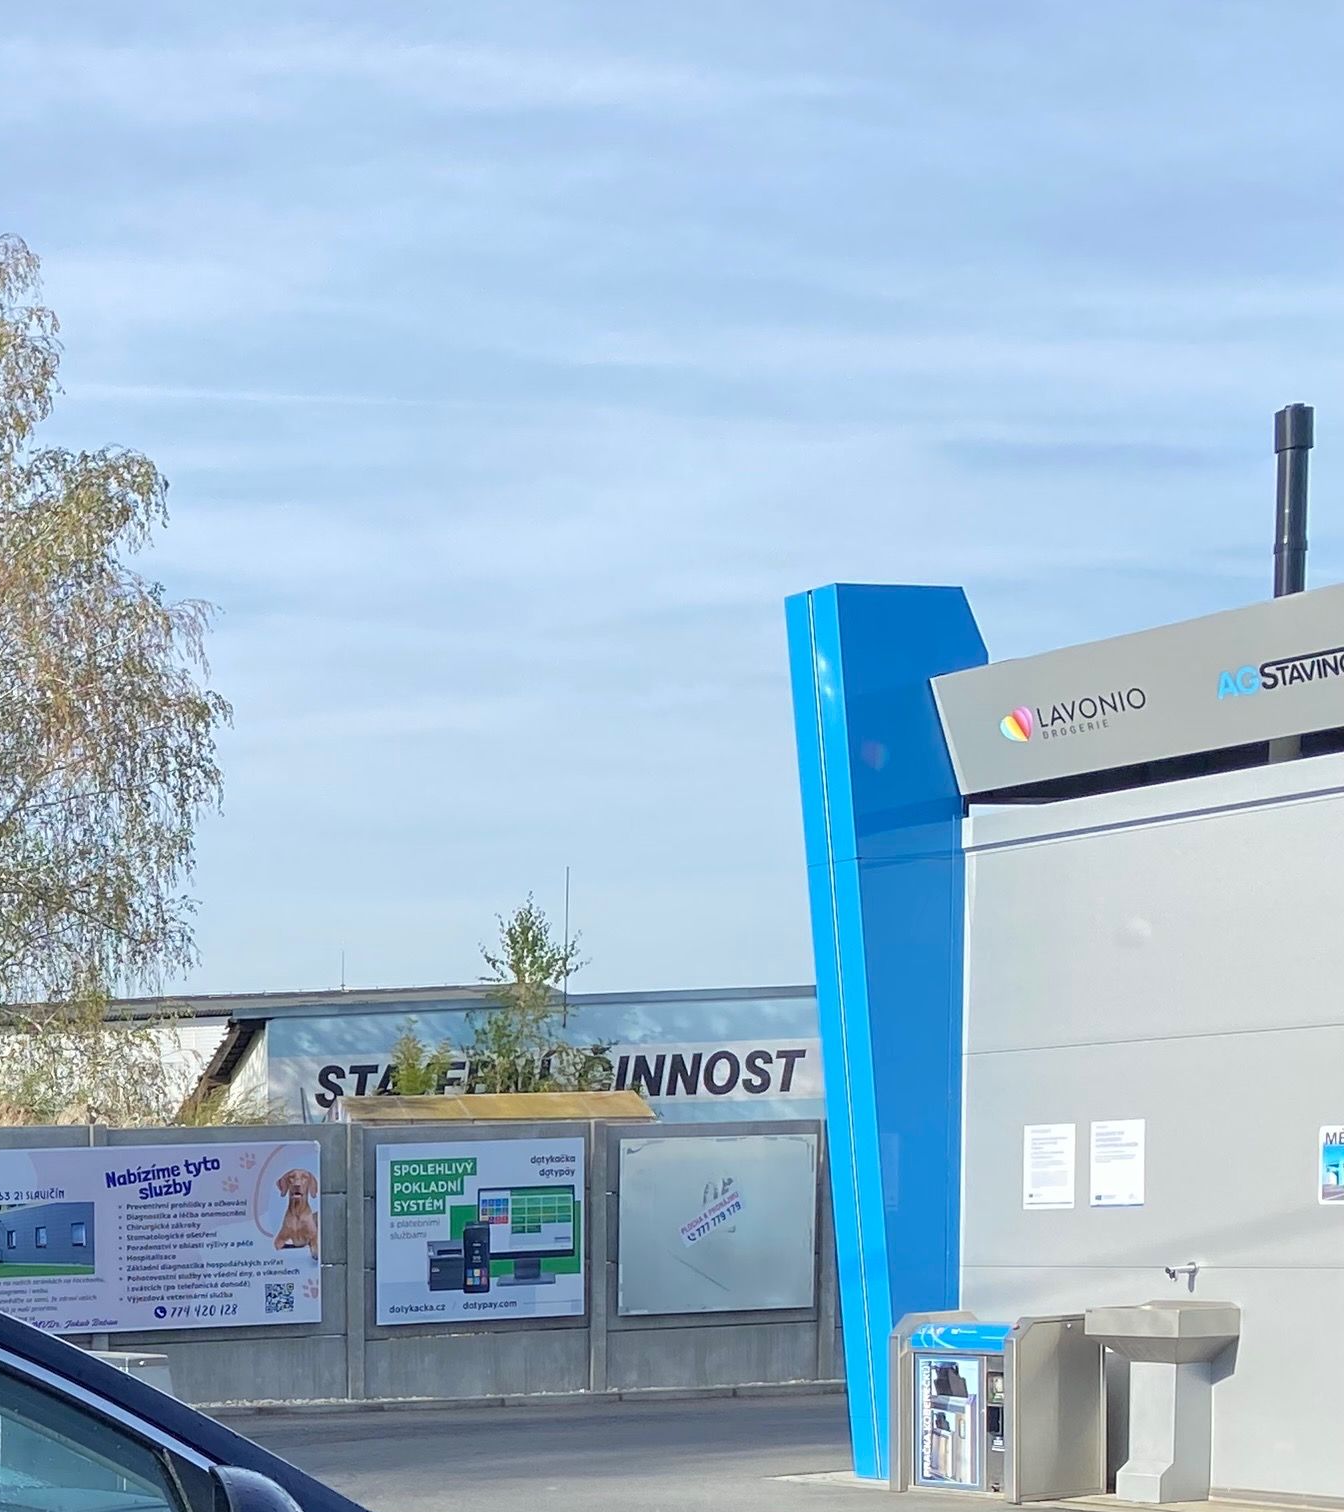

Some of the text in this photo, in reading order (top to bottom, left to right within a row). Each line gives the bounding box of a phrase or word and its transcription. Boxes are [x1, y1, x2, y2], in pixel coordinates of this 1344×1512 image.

[1036, 688, 1146, 728] LAVONIO
[1042, 719, 1109, 740] DROGERIE
[106, 1156, 220, 1188] Nabízíme tyto
[394, 1160, 473, 1176] SPOLEHLIVÝ
[138, 1180, 192, 1200] služby
[394, 1179, 461, 1194] POKLADNÍ
[14, 1191, 23, 1200] 21
[26, 1188, 65, 1200] SLAVIČÍN
[127, 1202, 169, 1210] Preventivní
[171, 1201, 205, 1210] prohlídky
[394, 1196, 444, 1212] SYSTÉM
[127, 1212, 171, 1222] Diagnostika
[696, 1201, 741, 1237] 777 779 179
[127, 1222, 201, 1232] Chirurgické zákroky
[396, 1219, 440, 1229] platebními
[127, 1231, 216, 1242] Stomatologické ošetření
[390, 1231, 427, 1240] službami
[127, 1243, 171, 1251] Poradenství
[179, 1241, 204, 1249] oblasti
[206, 1240, 228, 1249] výživy
[127, 1258, 283, 1272] Základní diagnostika hospodářských zvířat
[127, 1274, 176, 1282] Pohotovostní
[178, 1272, 202, 1281] služby
[262, 1268, 300, 1276] víkendech
[177, 1282, 218, 1290] telefonické
[127, 1291, 233, 1303] Výjezdová veterinární služba
[171, 1304, 238, 1317] 774 420 128
[389, 1300, 517, 1313] dotykacka.cz dotypay.com
[923, 1433, 931, 1478] PRAČKA
